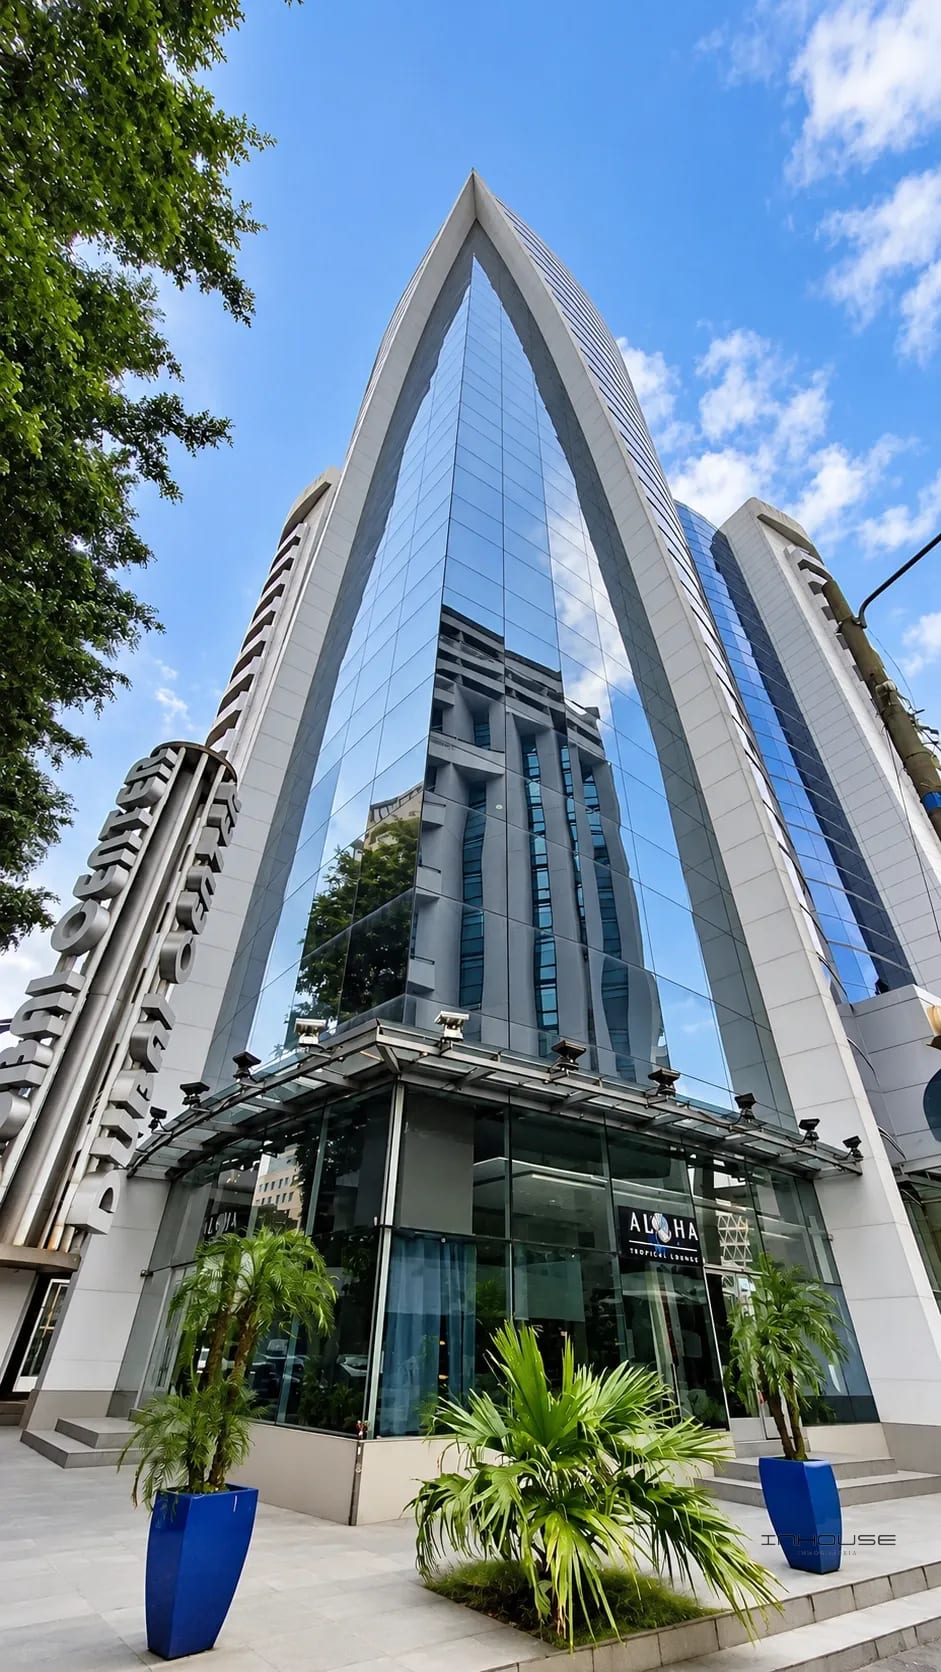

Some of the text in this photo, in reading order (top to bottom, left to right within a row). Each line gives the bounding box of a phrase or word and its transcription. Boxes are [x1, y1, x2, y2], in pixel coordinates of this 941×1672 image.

[51, 747, 177, 957] CENTER
[66, 781, 242, 1235] DUBAI CENTER
[630, 1211, 698, 1242] ALOHA
[630, 1247, 699, 1263] TROPICAL LOUNGE
